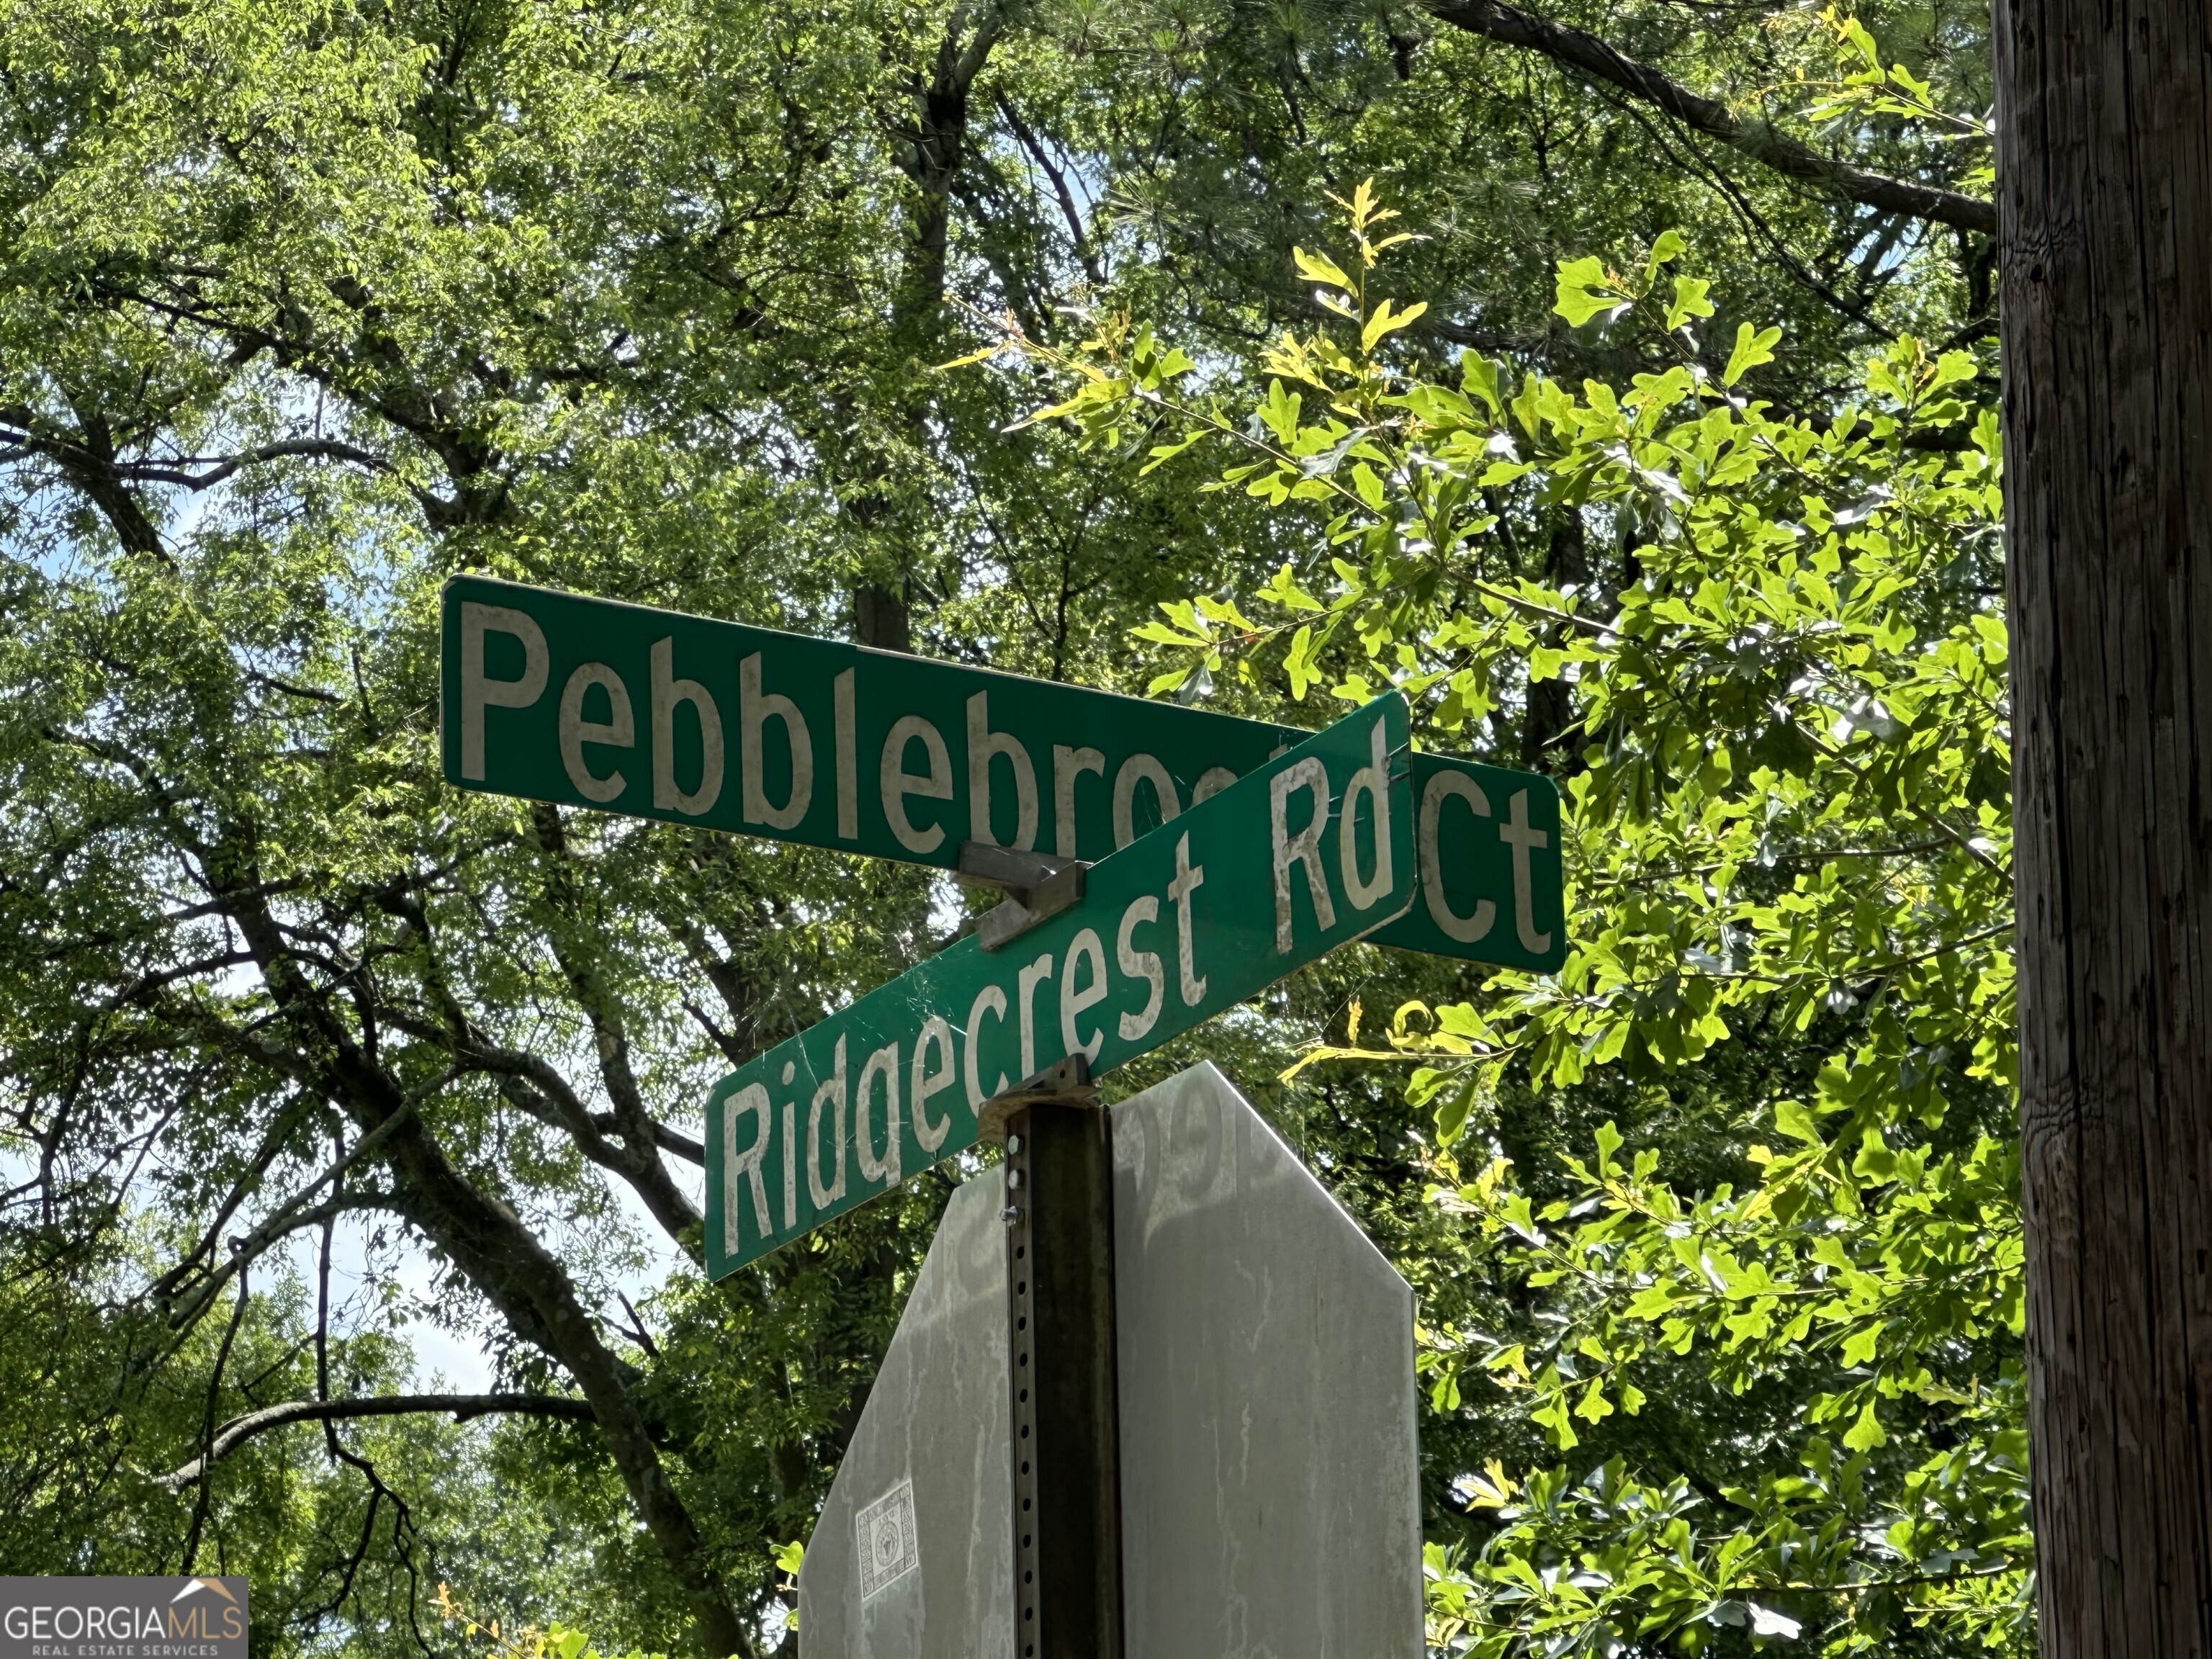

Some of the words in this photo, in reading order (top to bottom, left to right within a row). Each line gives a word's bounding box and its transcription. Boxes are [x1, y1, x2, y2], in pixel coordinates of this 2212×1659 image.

[461, 601, 1288, 858] Pebblebro
[1420, 769, 1552, 955] Ct
[1270, 714, 1393, 956] Rd
